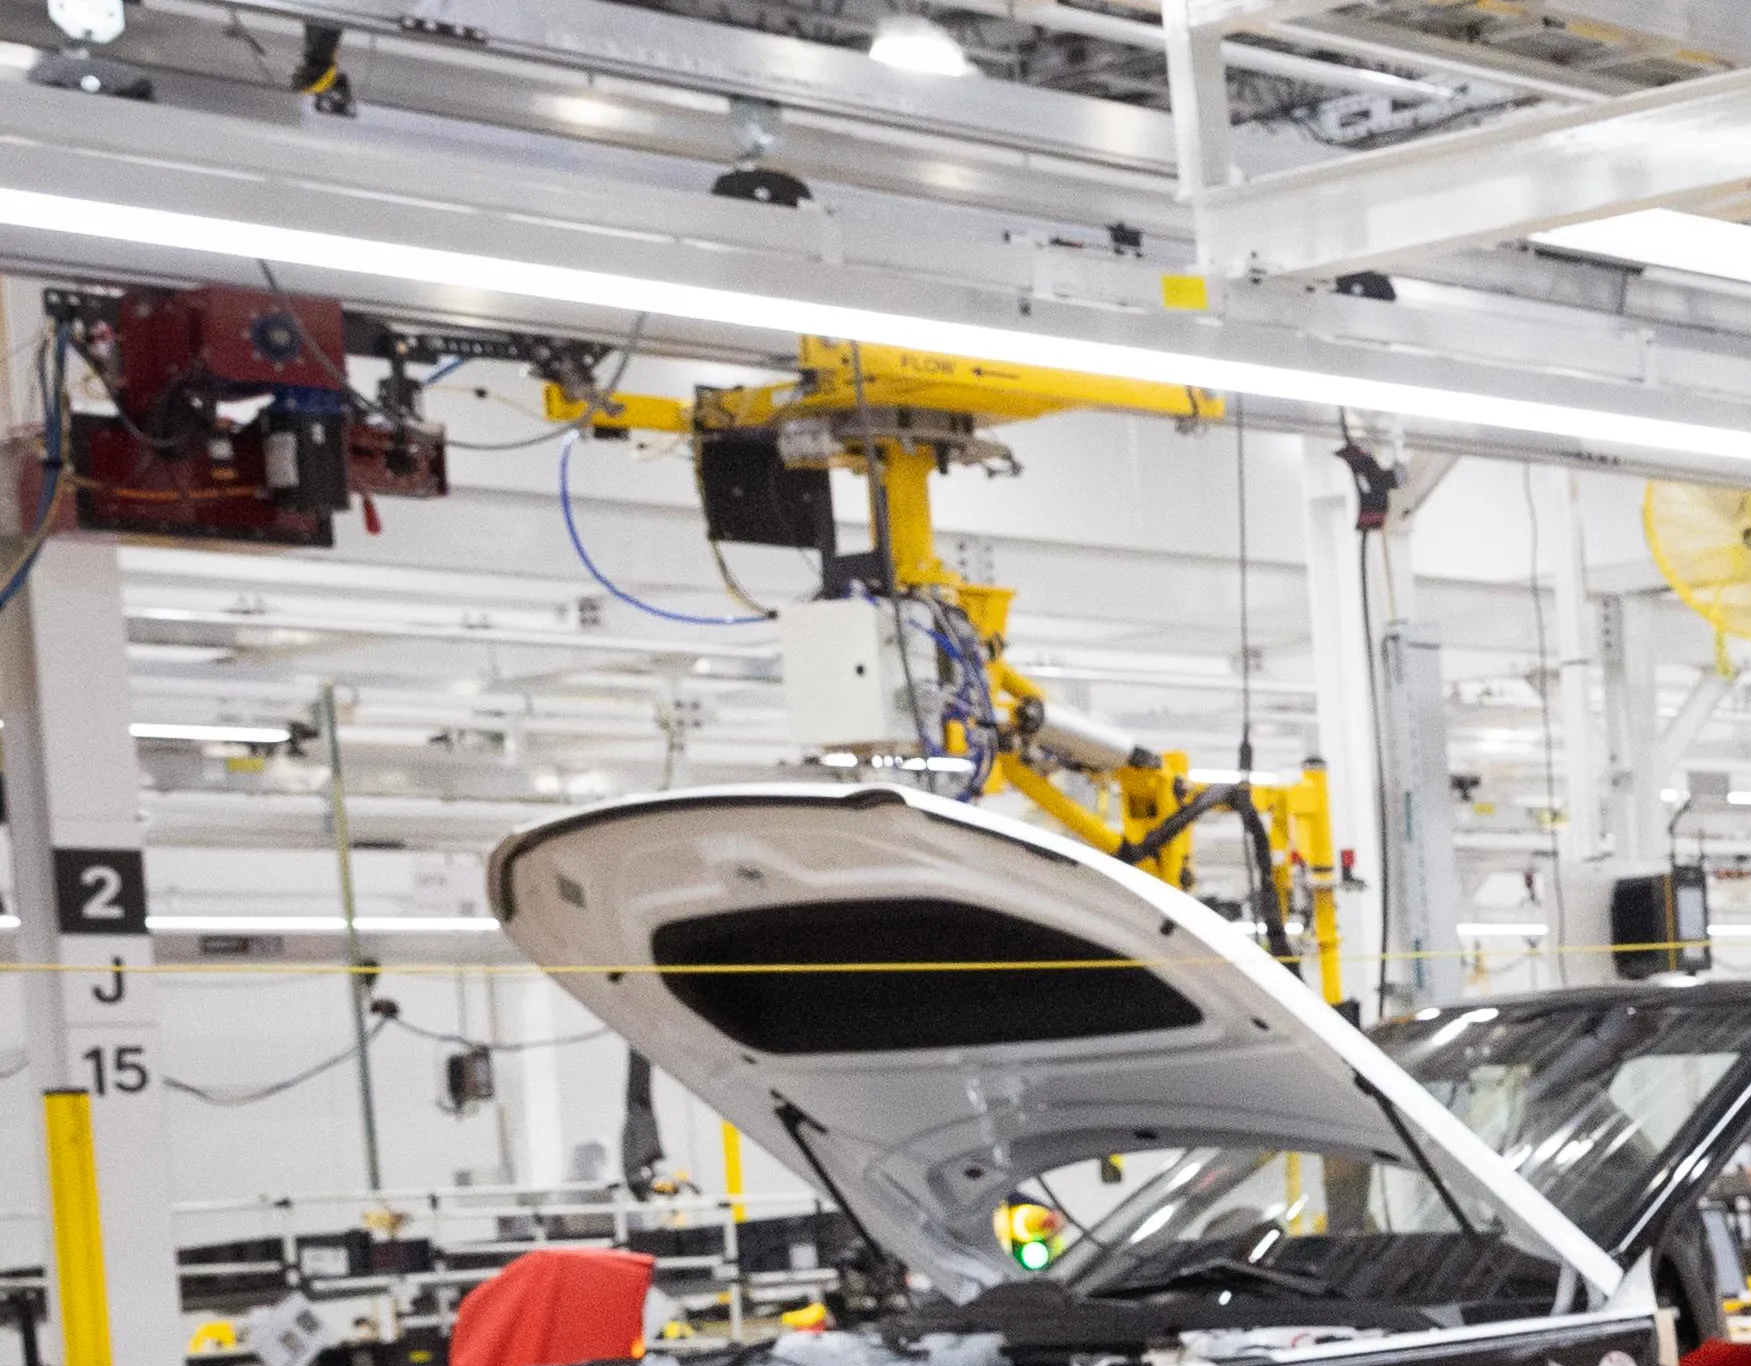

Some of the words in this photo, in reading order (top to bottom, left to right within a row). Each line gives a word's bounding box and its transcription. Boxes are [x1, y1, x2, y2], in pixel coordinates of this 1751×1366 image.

[80, 865, 125, 919] 2
[92, 957, 124, 1004] J
[82, 1045, 149, 1097] 15
